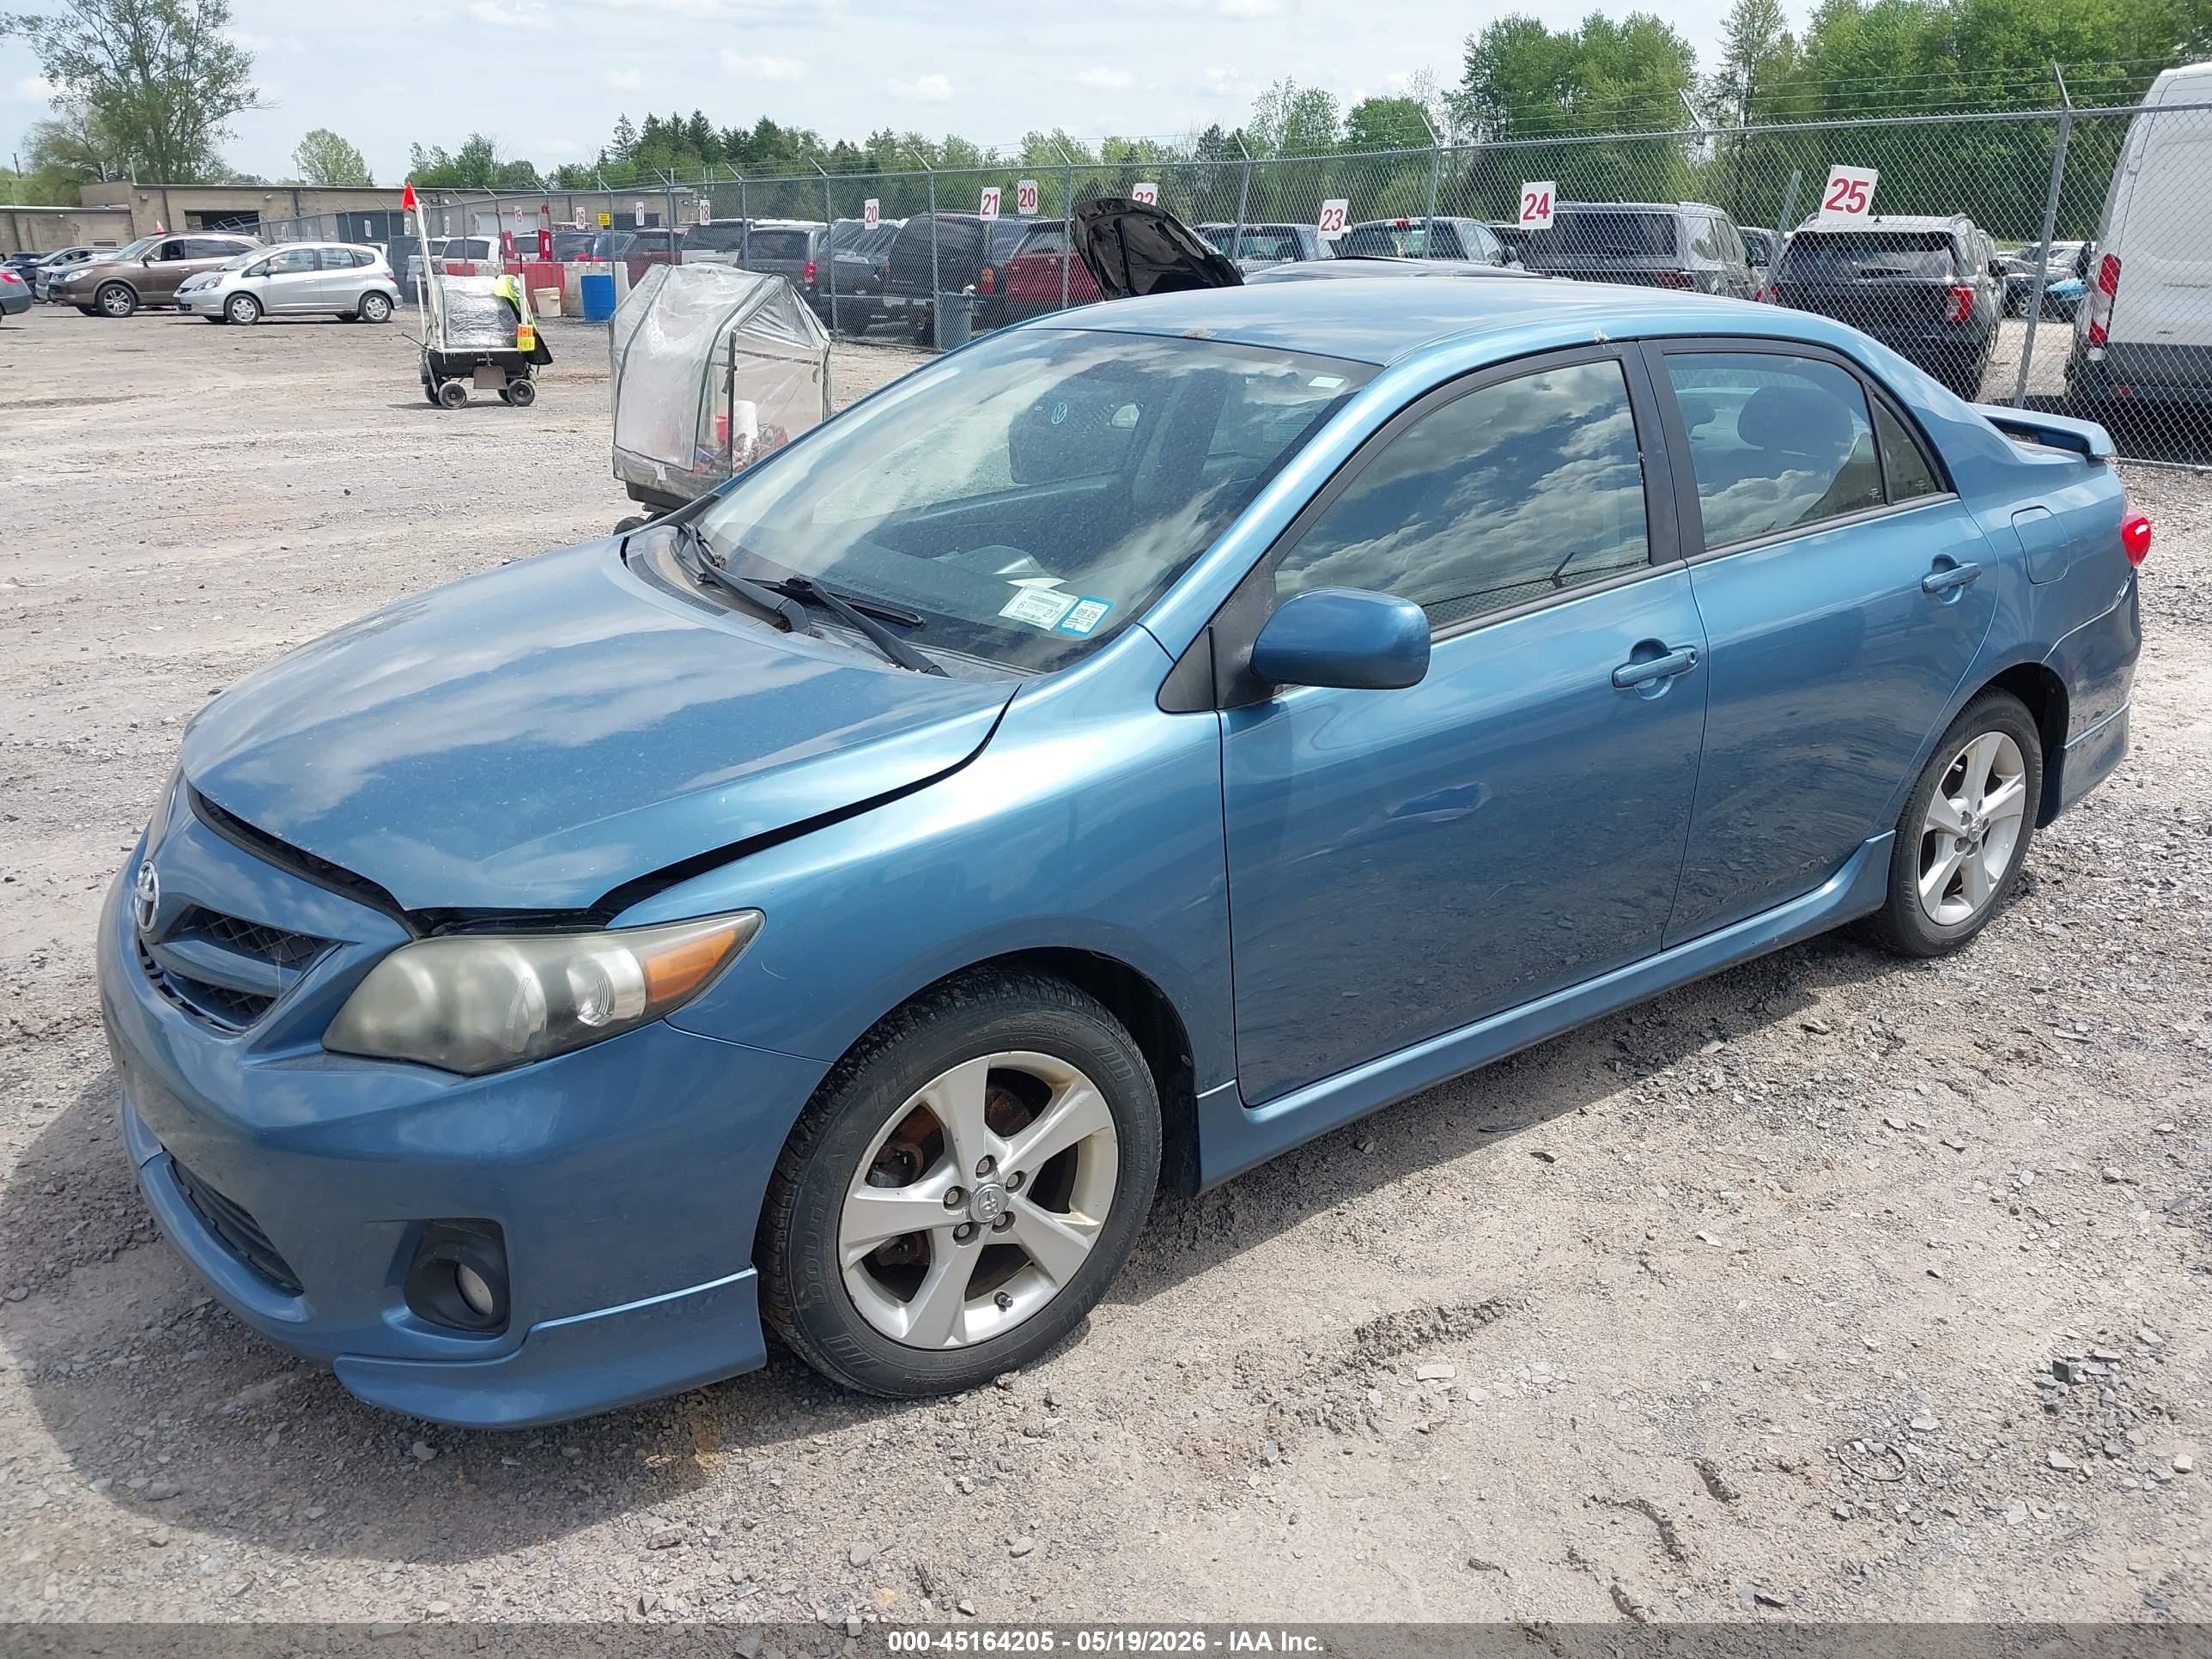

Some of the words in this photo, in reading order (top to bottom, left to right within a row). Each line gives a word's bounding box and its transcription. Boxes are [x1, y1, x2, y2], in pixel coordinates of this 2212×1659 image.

[981, 193, 999, 216] 21
[1018, 188, 1036, 208] 20
[1825, 178, 1869, 214] 25
[576, 210, 585, 222] 16
[636, 206, 644, 219] 17
[700, 204, 709, 222] 18
[866, 205, 878, 223] 20
[1522, 192, 1551, 221] 24
[1321, 209, 1344, 232] 23
